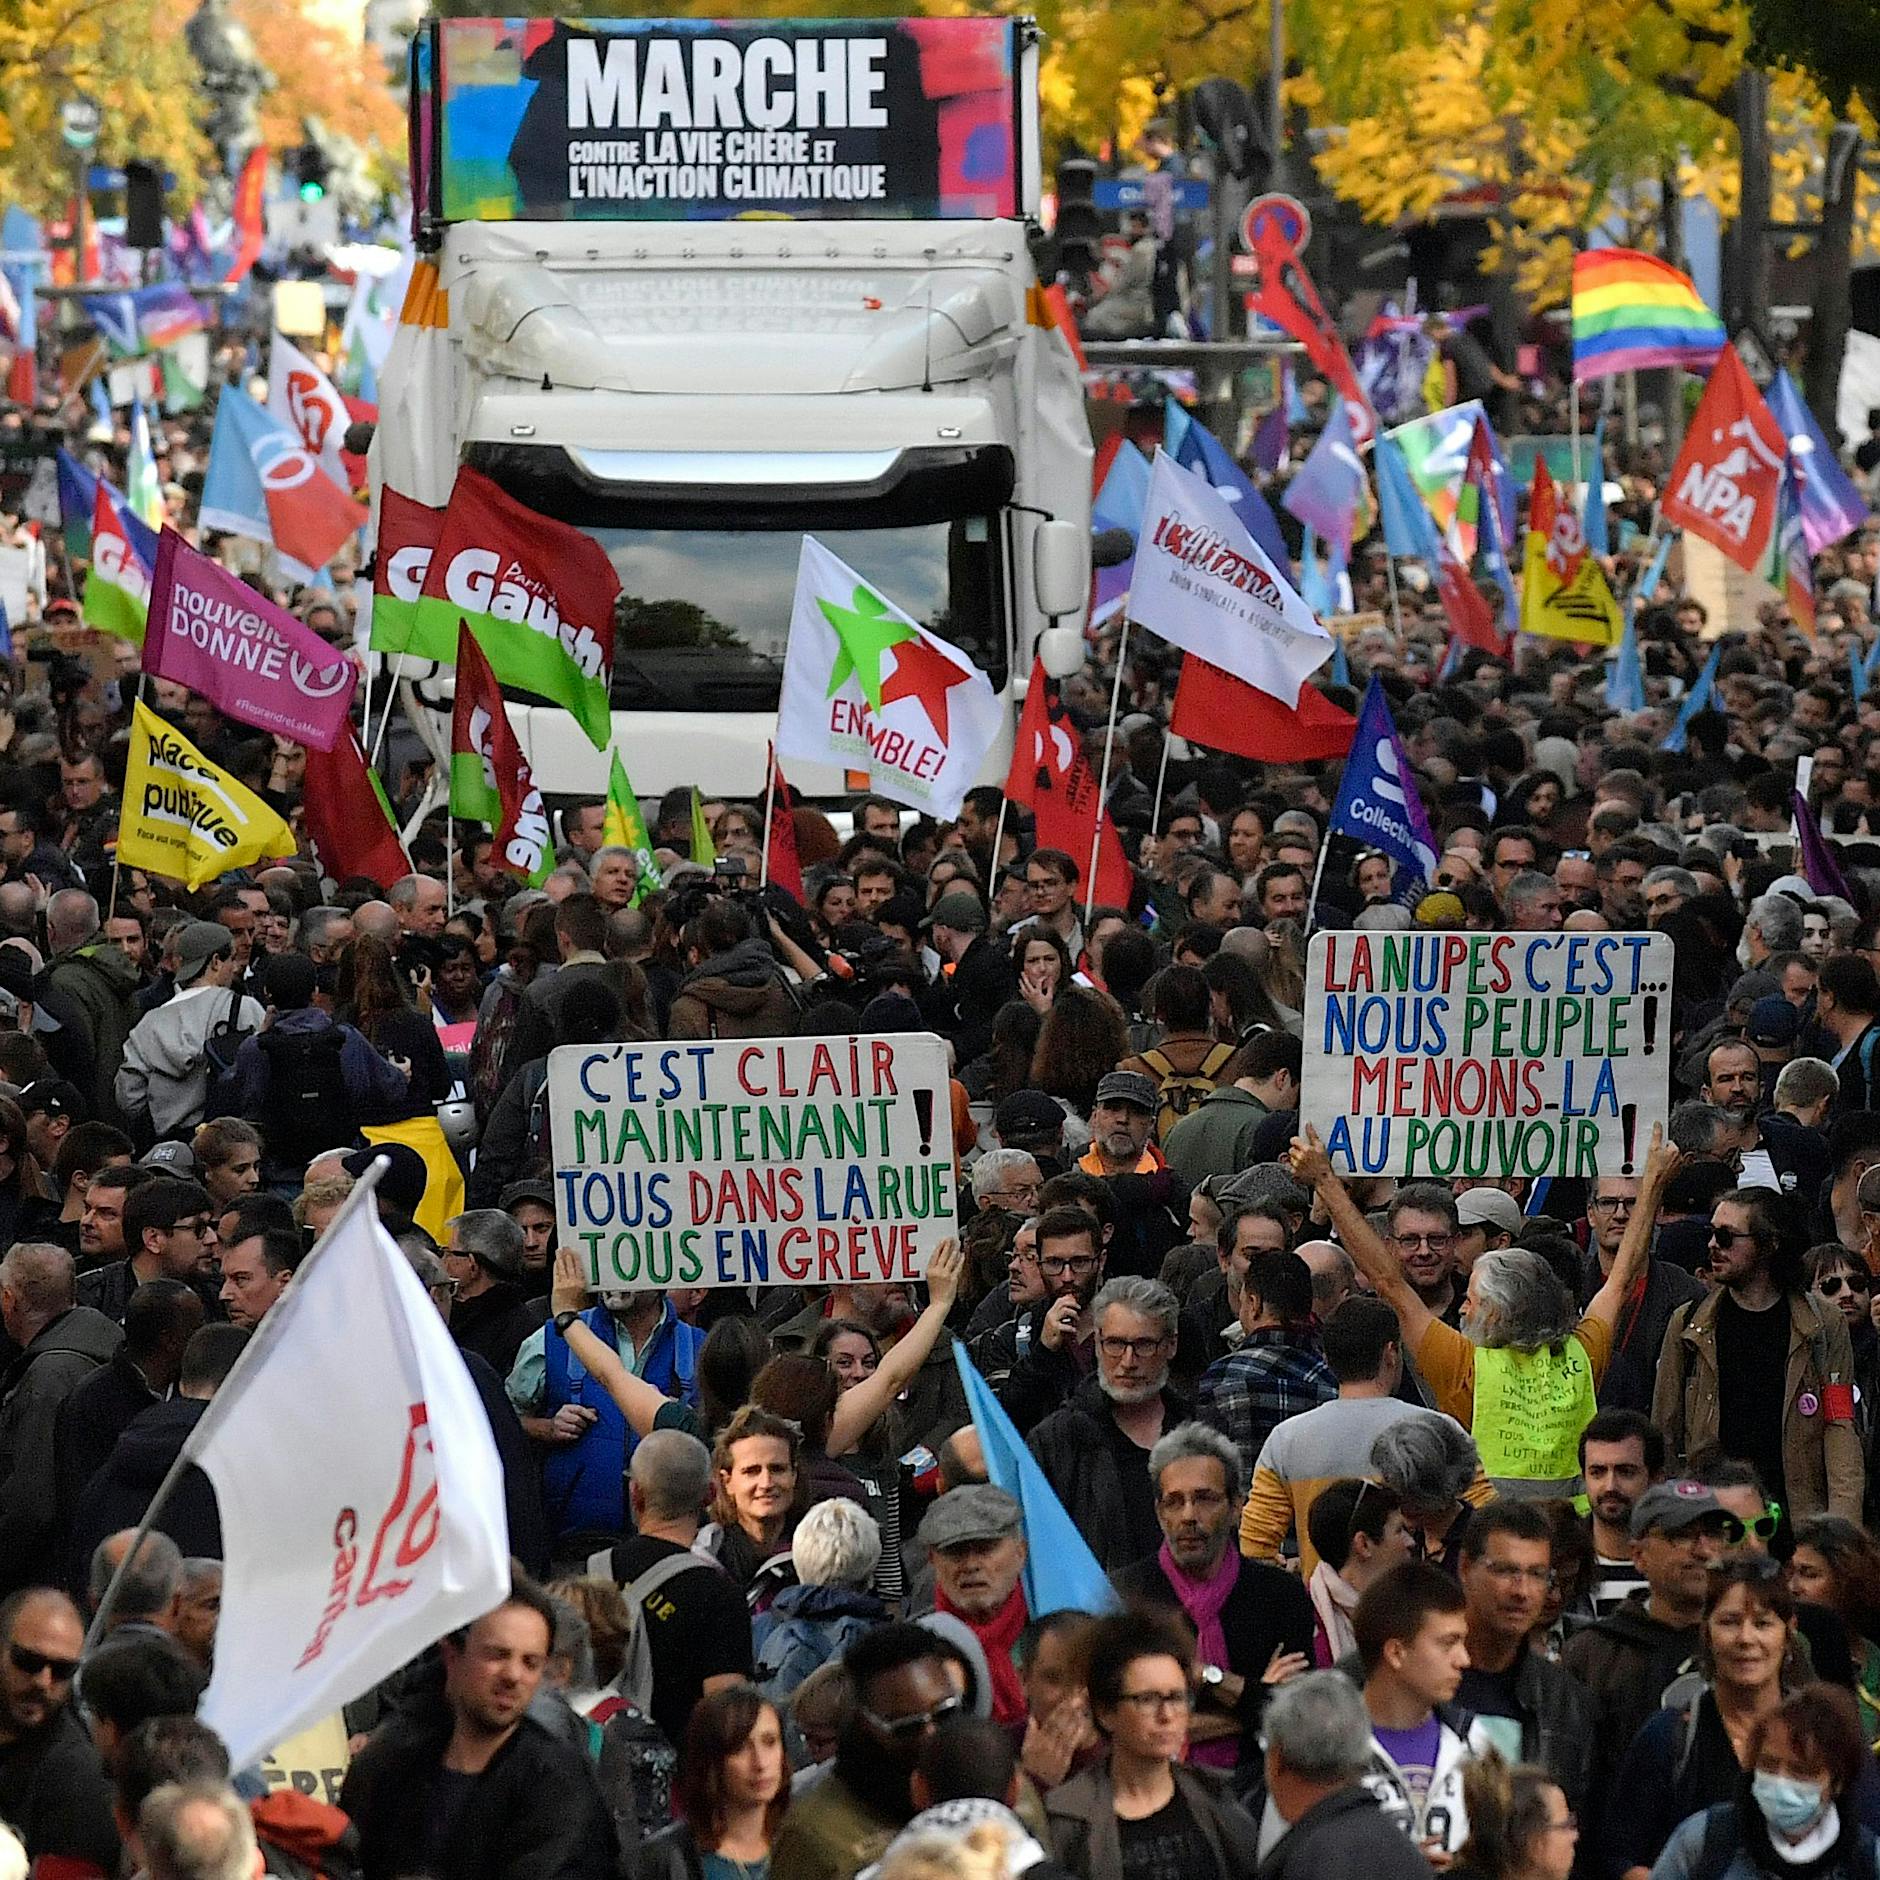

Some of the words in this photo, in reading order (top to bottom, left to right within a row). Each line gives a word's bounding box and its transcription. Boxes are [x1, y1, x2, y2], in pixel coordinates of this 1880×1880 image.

[567, 38, 889, 129] MARCHE
[568, 141, 640, 164] CONTRE
[645, 131, 678, 164] LA
[681, 131, 723, 164] VIE
[725, 126, 809, 164] CHÈRE
[813, 140, 837, 163] ET
[569, 165, 717, 199] L'INACTION
[723, 165, 887, 200] CLIMATIQUE
[1676, 462, 1757, 544] NPA
[171, 606, 287, 681] DONNE
[1324, 935, 1373, 993] LA
[1382, 936, 1515, 994] NUPES
[1324, 994, 1449, 1056] NOUS
[1463, 996, 1631, 1057] PEUPLE
[580, 1046, 714, 1103] C'EST
[1327, 1115, 1391, 1173] AU
[557, 1171, 672, 1228] TOUS
[689, 1167, 803, 1225] DANS
[815, 1165, 873, 1221] LA
[879, 1163, 953, 1219] RUE
[579, 1231, 704, 1286] TOUS
[716, 1230, 767, 1283] EN
[778, 1217, 920, 1280] GRÈVE
